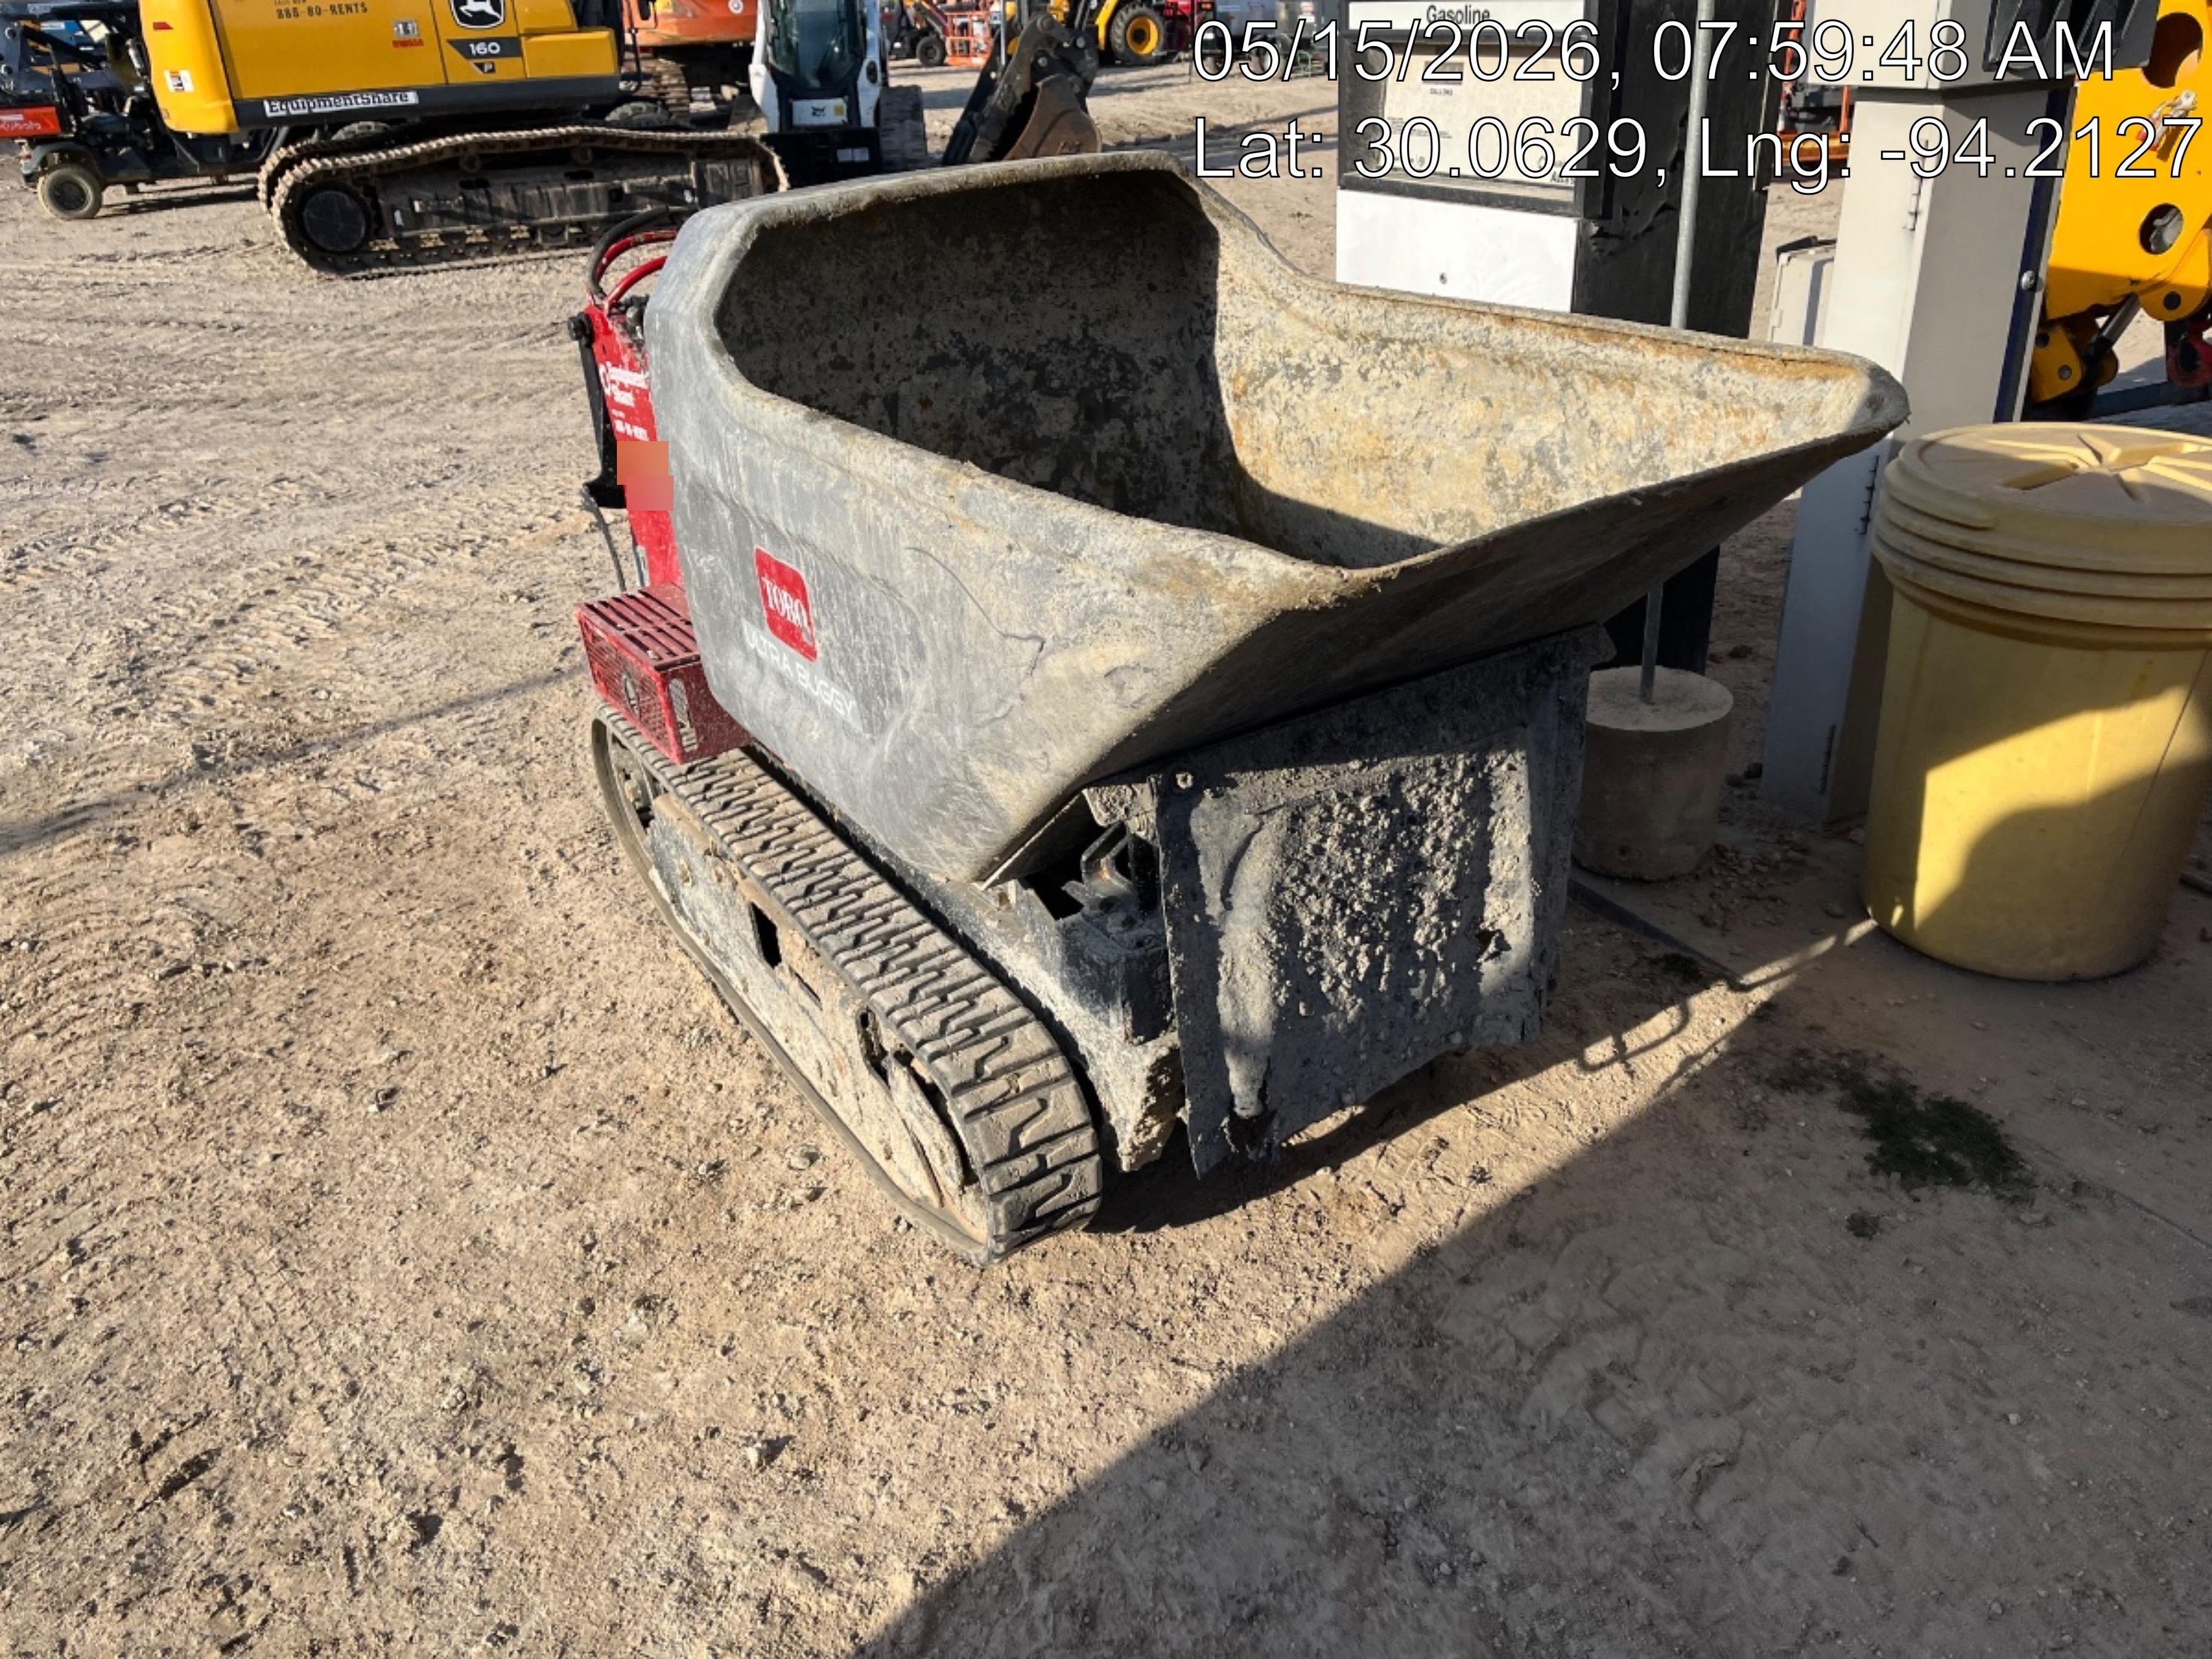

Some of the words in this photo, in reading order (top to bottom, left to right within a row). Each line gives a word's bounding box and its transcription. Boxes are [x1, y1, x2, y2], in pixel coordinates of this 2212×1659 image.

[1426, 4, 1490, 25] Gasoline
[469, 41, 500, 56] 160
[269, 92, 409, 115] EquipmentShare
[761, 573, 815, 644] TORO
